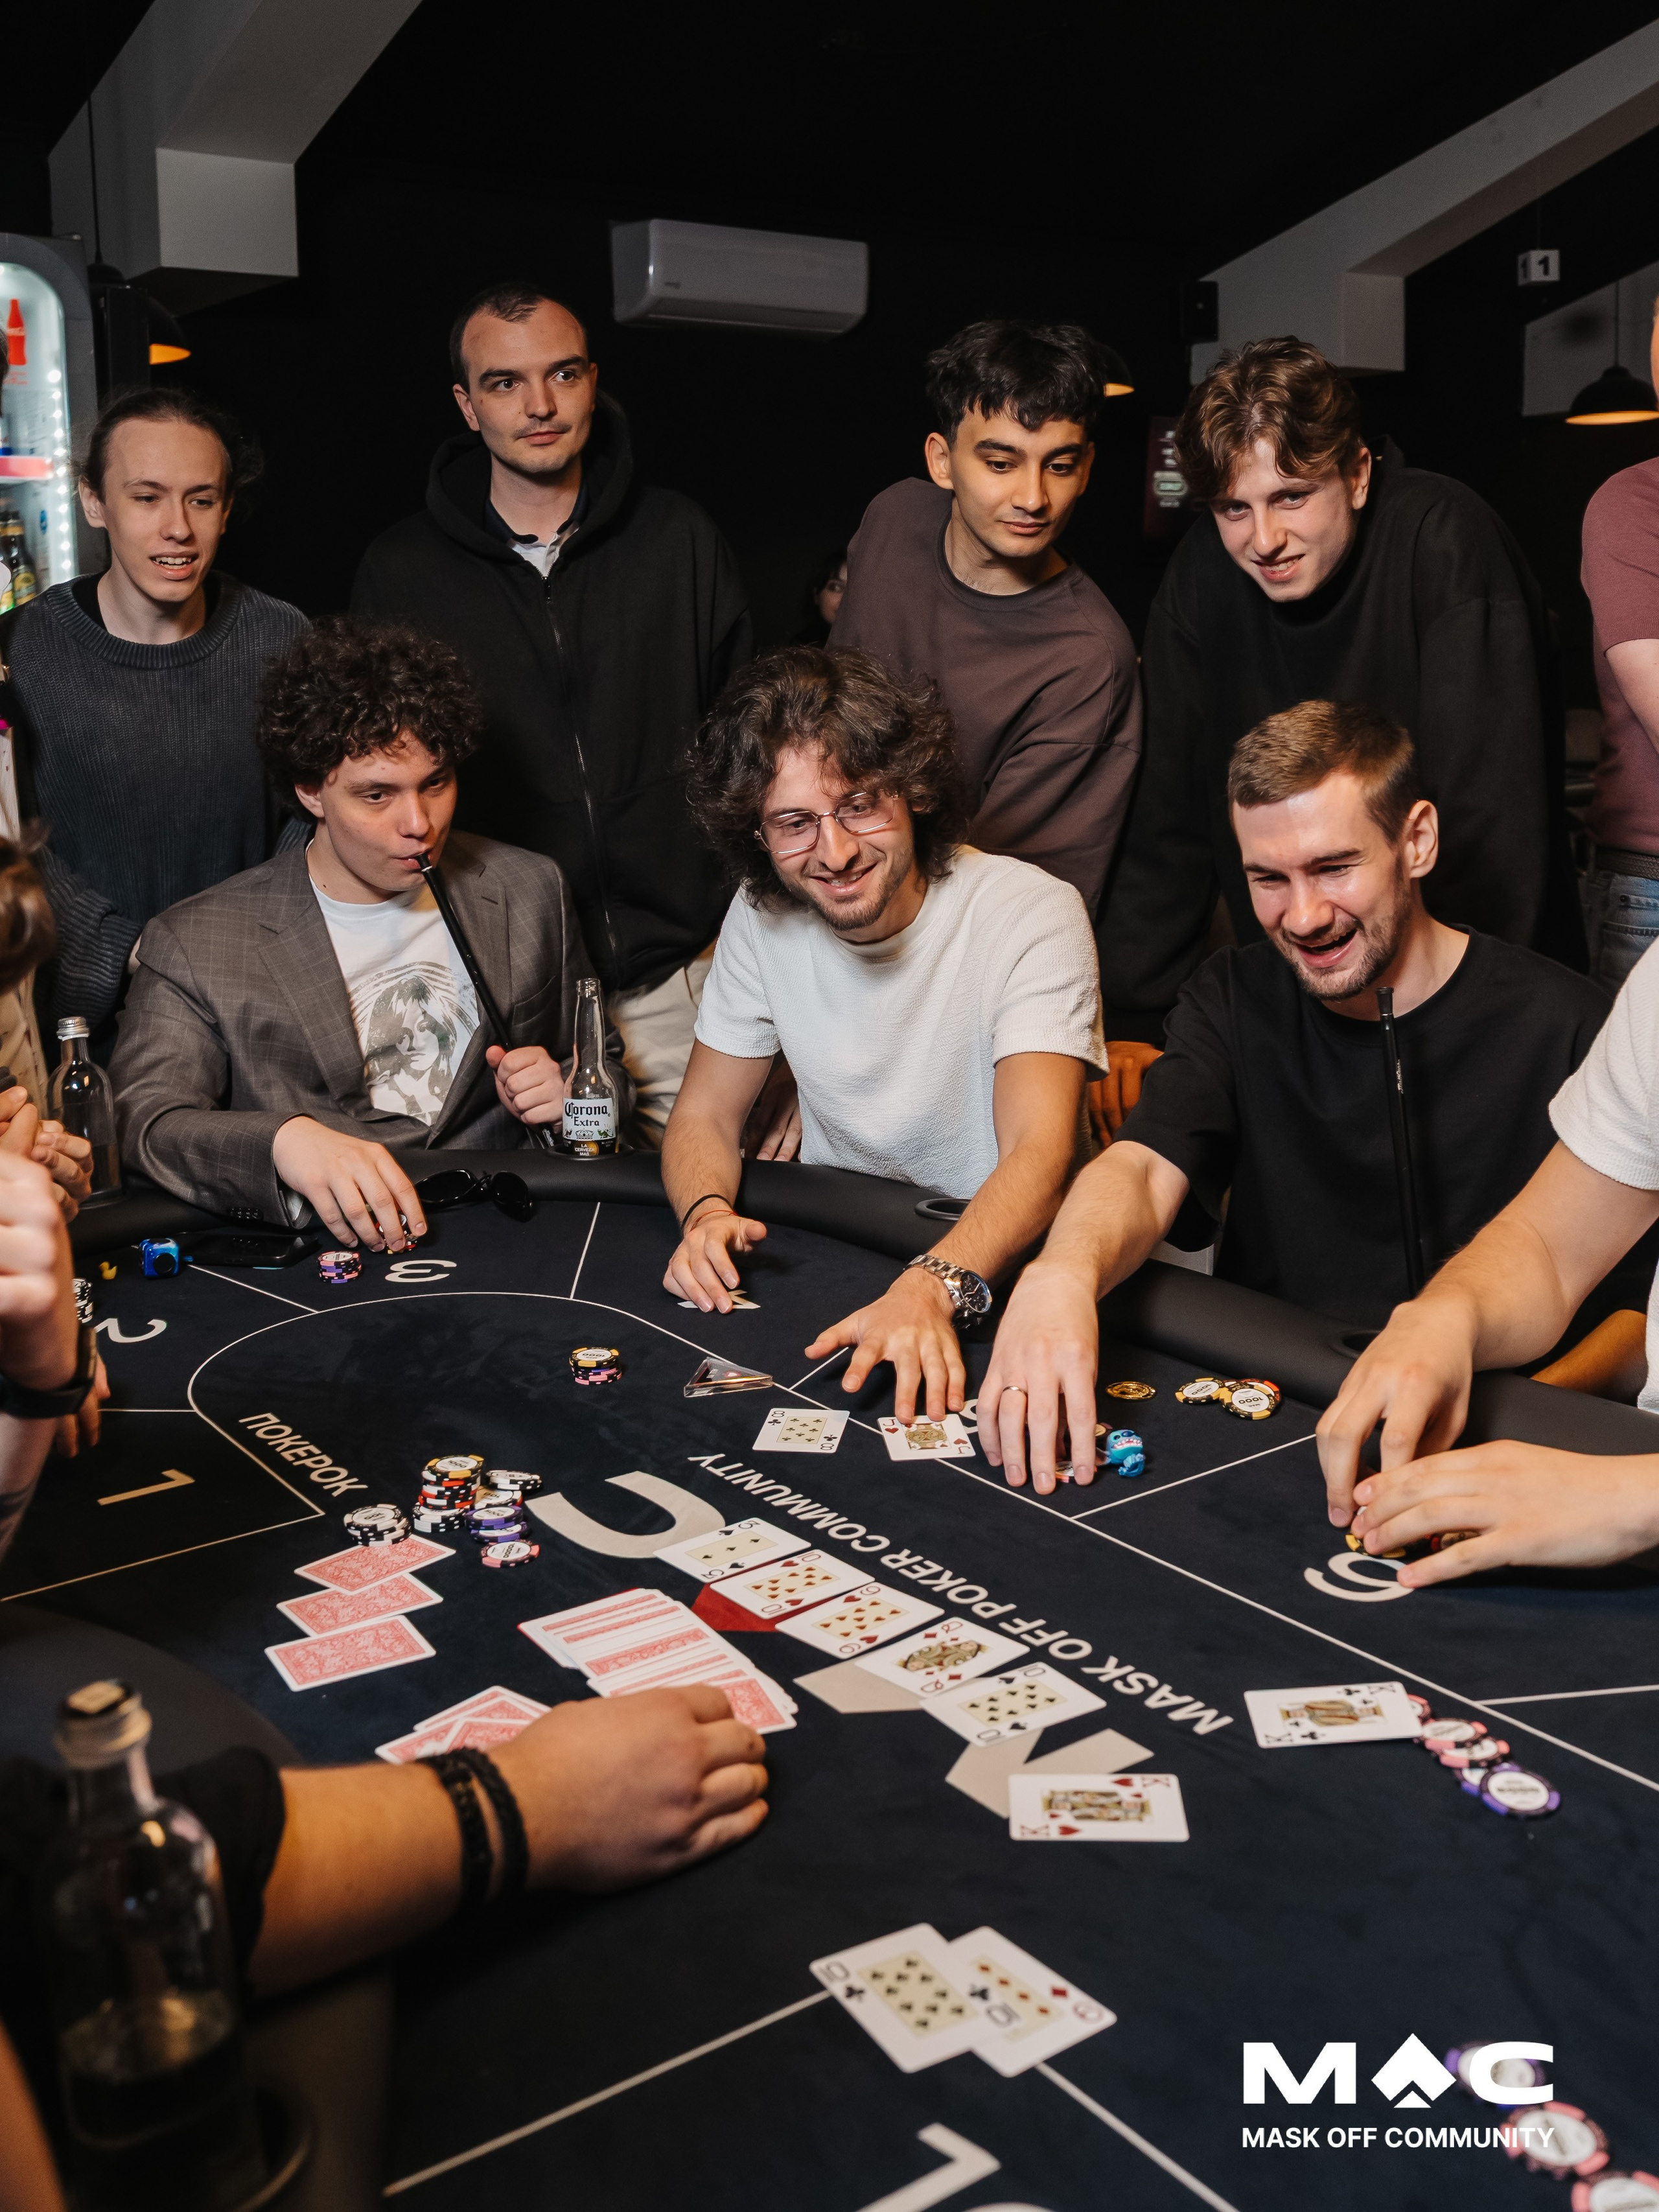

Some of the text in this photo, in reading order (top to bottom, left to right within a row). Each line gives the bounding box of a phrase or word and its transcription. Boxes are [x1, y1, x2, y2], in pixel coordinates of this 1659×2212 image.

[1538, 255, 1549, 276] 1
[564, 1102, 608, 1119] Corona
[574, 1117, 599, 1126] Extra
[385, 1259, 457, 1283] 3
[94, 1318, 167, 1344] 2
[1191, 1383, 1212, 1395] 1000
[1238, 1396, 1264, 1404] 1000
[238, 1412, 368, 1497] ПОКЕРОК
[958, 1446, 971, 1454] J
[97, 1469, 195, 1506] 1
[738, 1520, 760, 1530] 3
[797, 1550, 821, 1563] 10
[701, 1568, 724, 1579] 3
[688, 1453, 1233, 1735] MASK OFF POKER COMMUNITY
[761, 1603, 787, 1615] 10
[941, 1621, 964, 1634] Q
[1017, 1664, 1046, 1677] 10
[920, 1679, 944, 1693] Q
[1367, 1684, 1396, 1695] K
[977, 1729, 1006, 1743] 10
[1264, 1732, 1294, 1743] K
[1141, 1776, 1171, 1787] K
[1019, 1824, 1050, 1837] K
[819, 1961, 850, 1983] 10
[986, 2003, 1021, 2027] 10
